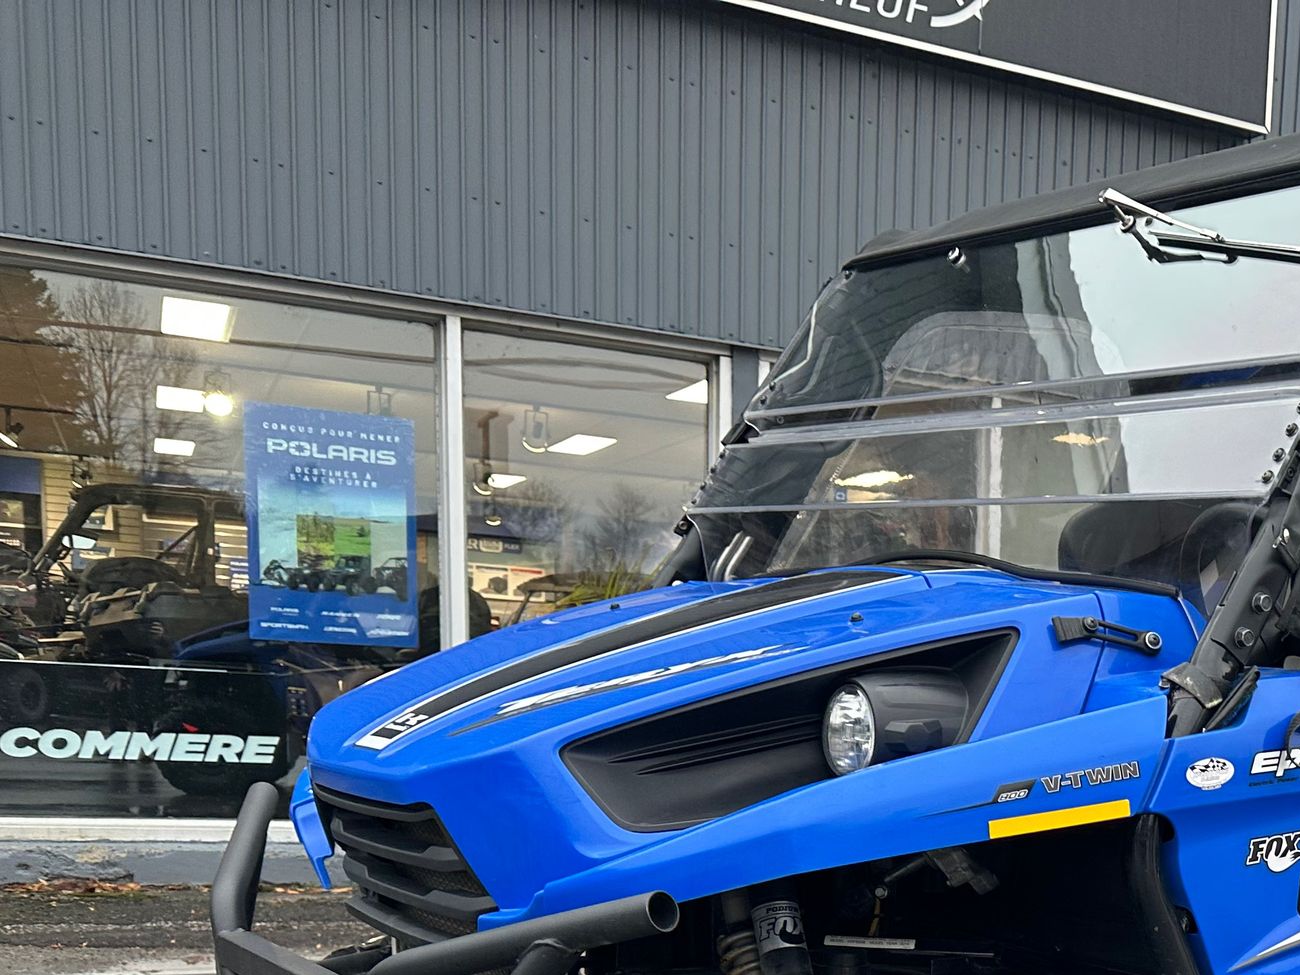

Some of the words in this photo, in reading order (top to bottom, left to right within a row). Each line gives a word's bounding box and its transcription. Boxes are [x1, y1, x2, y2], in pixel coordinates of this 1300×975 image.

[320, 428, 353, 438] POUR
[360, 432, 401, 443] MENER
[266, 437, 397, 466] POLARIS
[1041, 761, 1140, 794] V-TWIN
